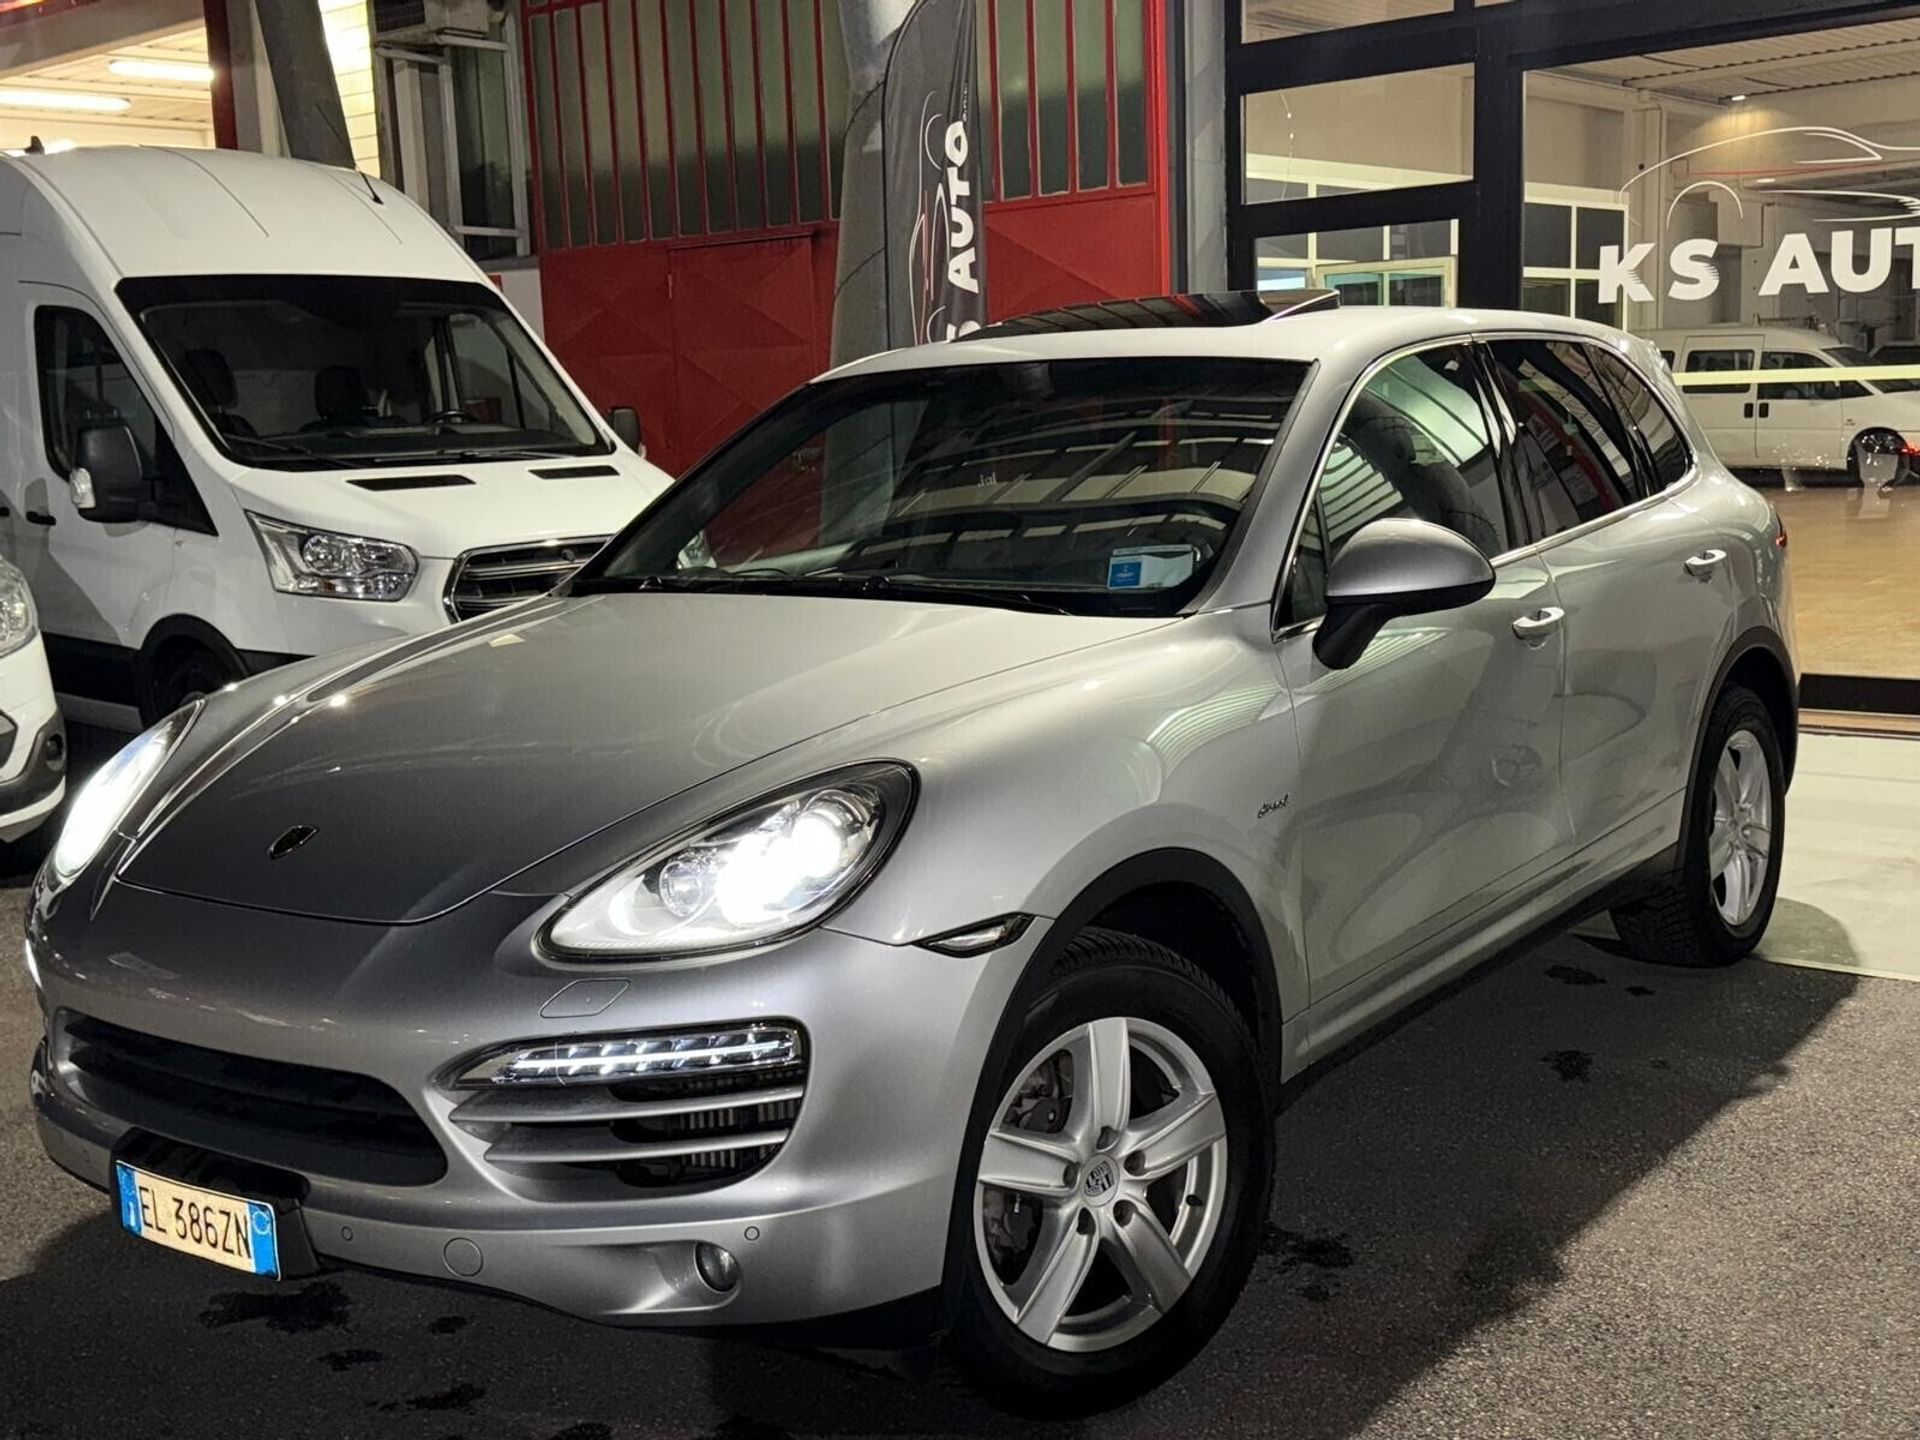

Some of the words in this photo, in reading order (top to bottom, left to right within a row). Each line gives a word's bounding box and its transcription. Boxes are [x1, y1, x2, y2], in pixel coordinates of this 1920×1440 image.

[945, 120, 979, 294] AUTO
[139, 1186, 167, 1233] EL
[172, 1197, 252, 1259] 386ZN
